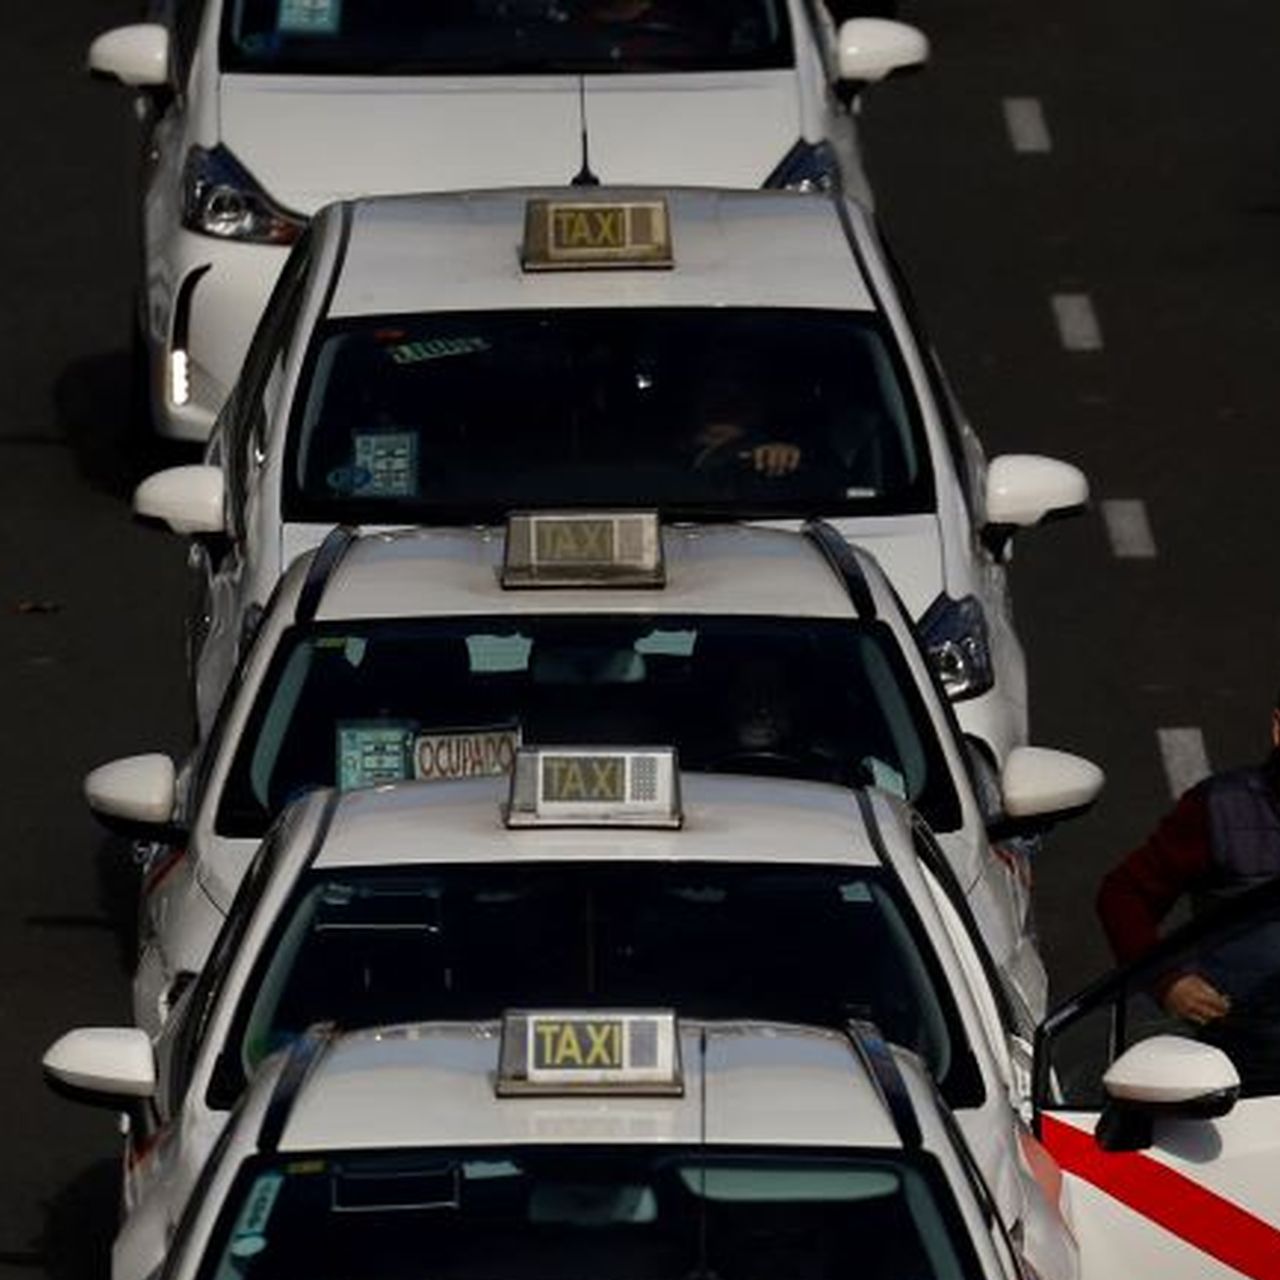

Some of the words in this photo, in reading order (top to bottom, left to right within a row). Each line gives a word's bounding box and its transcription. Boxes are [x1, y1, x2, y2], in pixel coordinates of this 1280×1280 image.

[555, 213, 622, 246] TAXI
[538, 522, 612, 559] TAXI
[421, 736, 515, 776] OCUPADO
[547, 760, 621, 798] TAXI
[537, 1024, 621, 1065] TAXI
